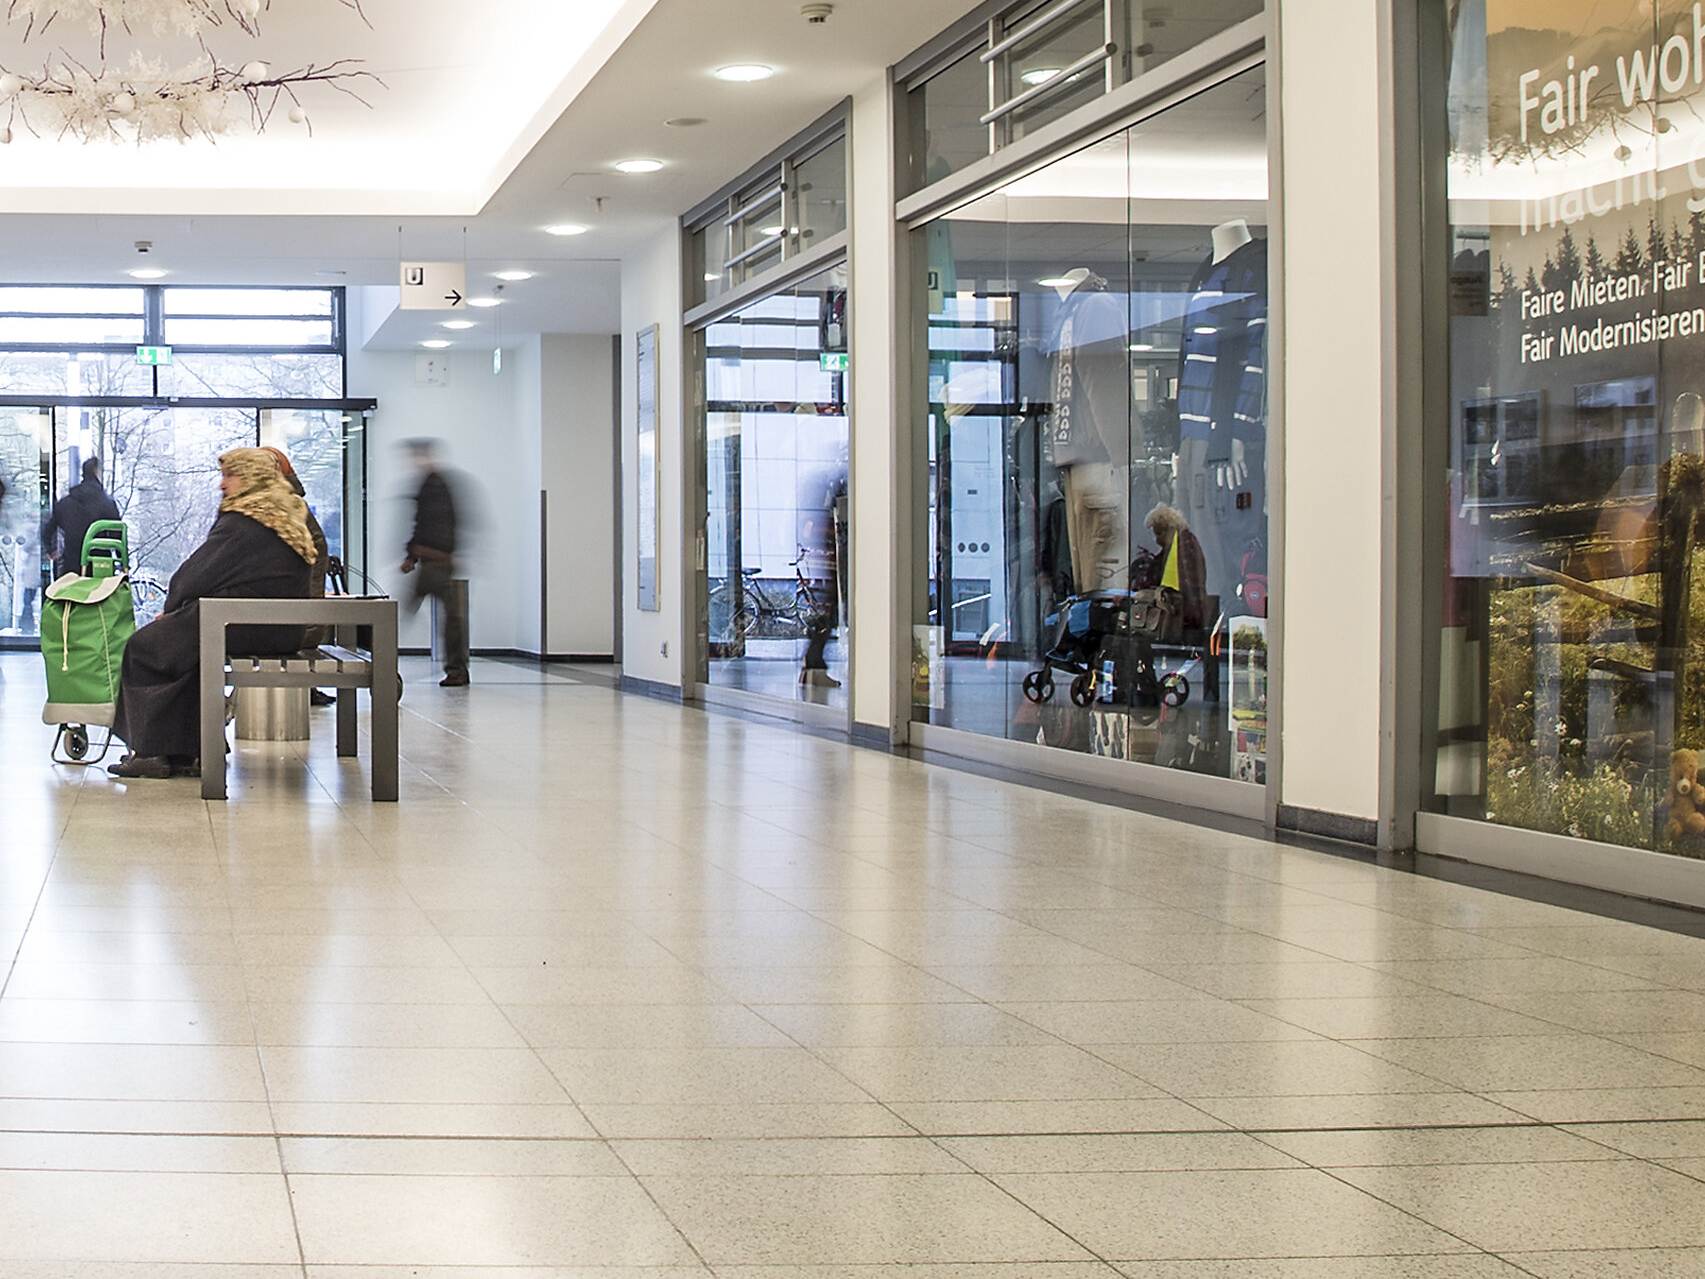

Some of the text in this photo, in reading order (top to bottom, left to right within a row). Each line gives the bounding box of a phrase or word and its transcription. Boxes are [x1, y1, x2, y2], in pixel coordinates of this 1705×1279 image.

[1519, 55, 1599, 143] Fair
[405, 267, 423, 285] U
[1521, 286, 1566, 320] Faire
[1570, 274, 1646, 311] Mieten.
[1653, 256, 1693, 293] Fair
[1521, 307, 1705, 363] Fair Modernisieren
